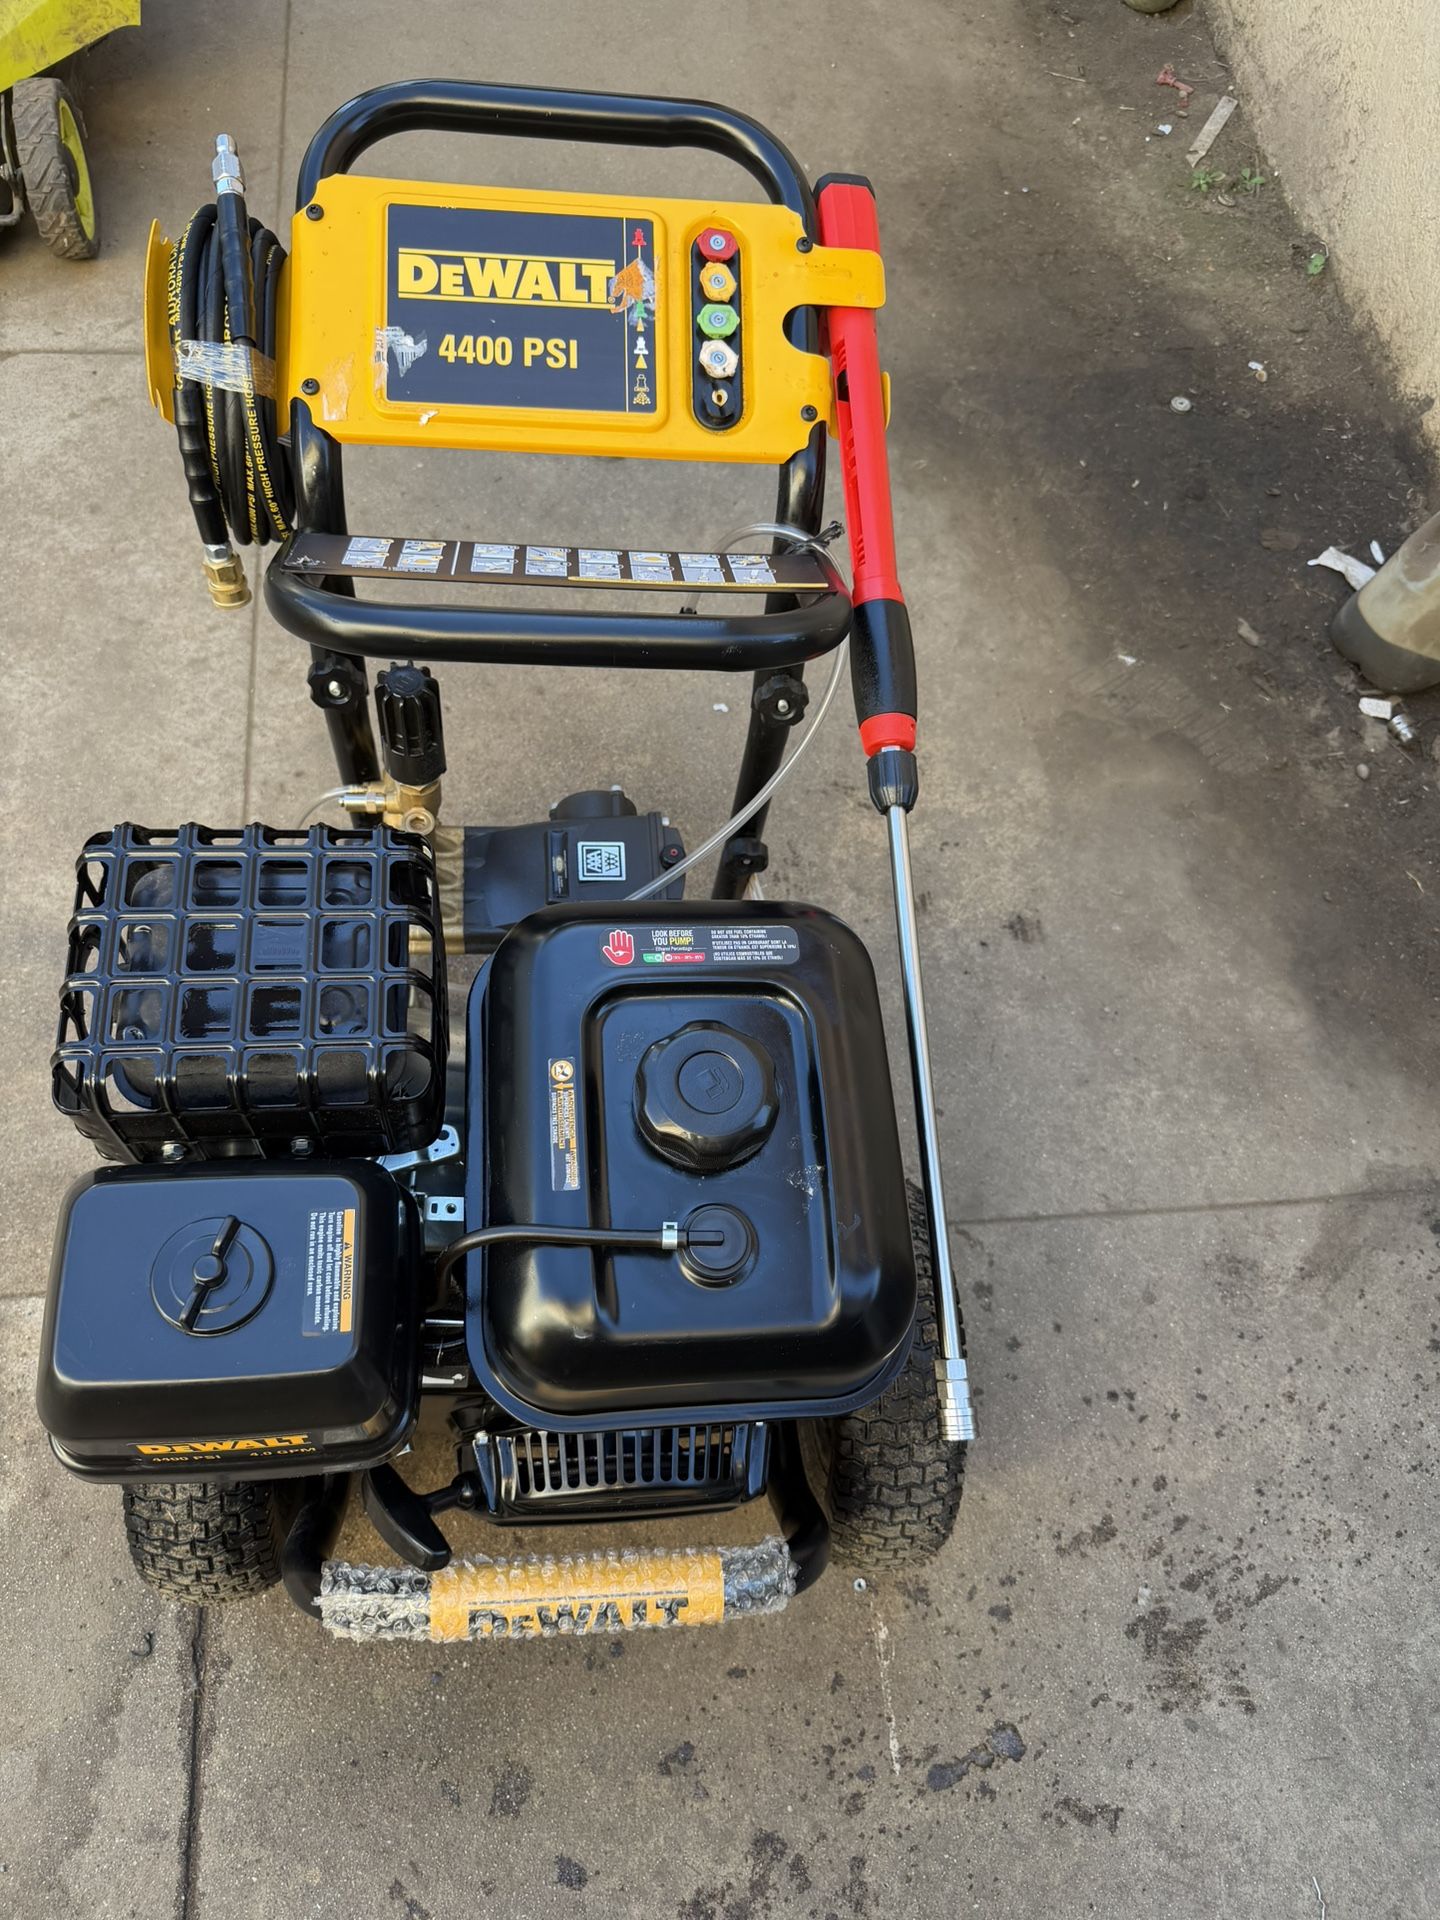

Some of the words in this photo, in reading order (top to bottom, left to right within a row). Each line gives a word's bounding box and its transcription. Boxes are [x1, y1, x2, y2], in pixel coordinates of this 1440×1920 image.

[438, 334, 513, 366] 4400
[523, 336, 578, 369] PSI
[206, 402, 218, 461] PRESSURE
[247, 410, 268, 472] PRESSURE
[259, 473, 274, 500] HIGH
[653, 937, 668, 946] YOU
[669, 937, 694, 945] PUMP!
[317, 1225, 325, 1242] engine
[326, 1225, 334, 1242] engine
[333, 1244, 342, 1260] highly
[307, 1256, 315, 1281] enclosed
[343, 1255, 352, 1300] WARNING
[314, 1296, 322, 1325] monoxide.
[136, 1434, 308, 1454] DEWALT
[469, 1598, 688, 1637] DEWALT
